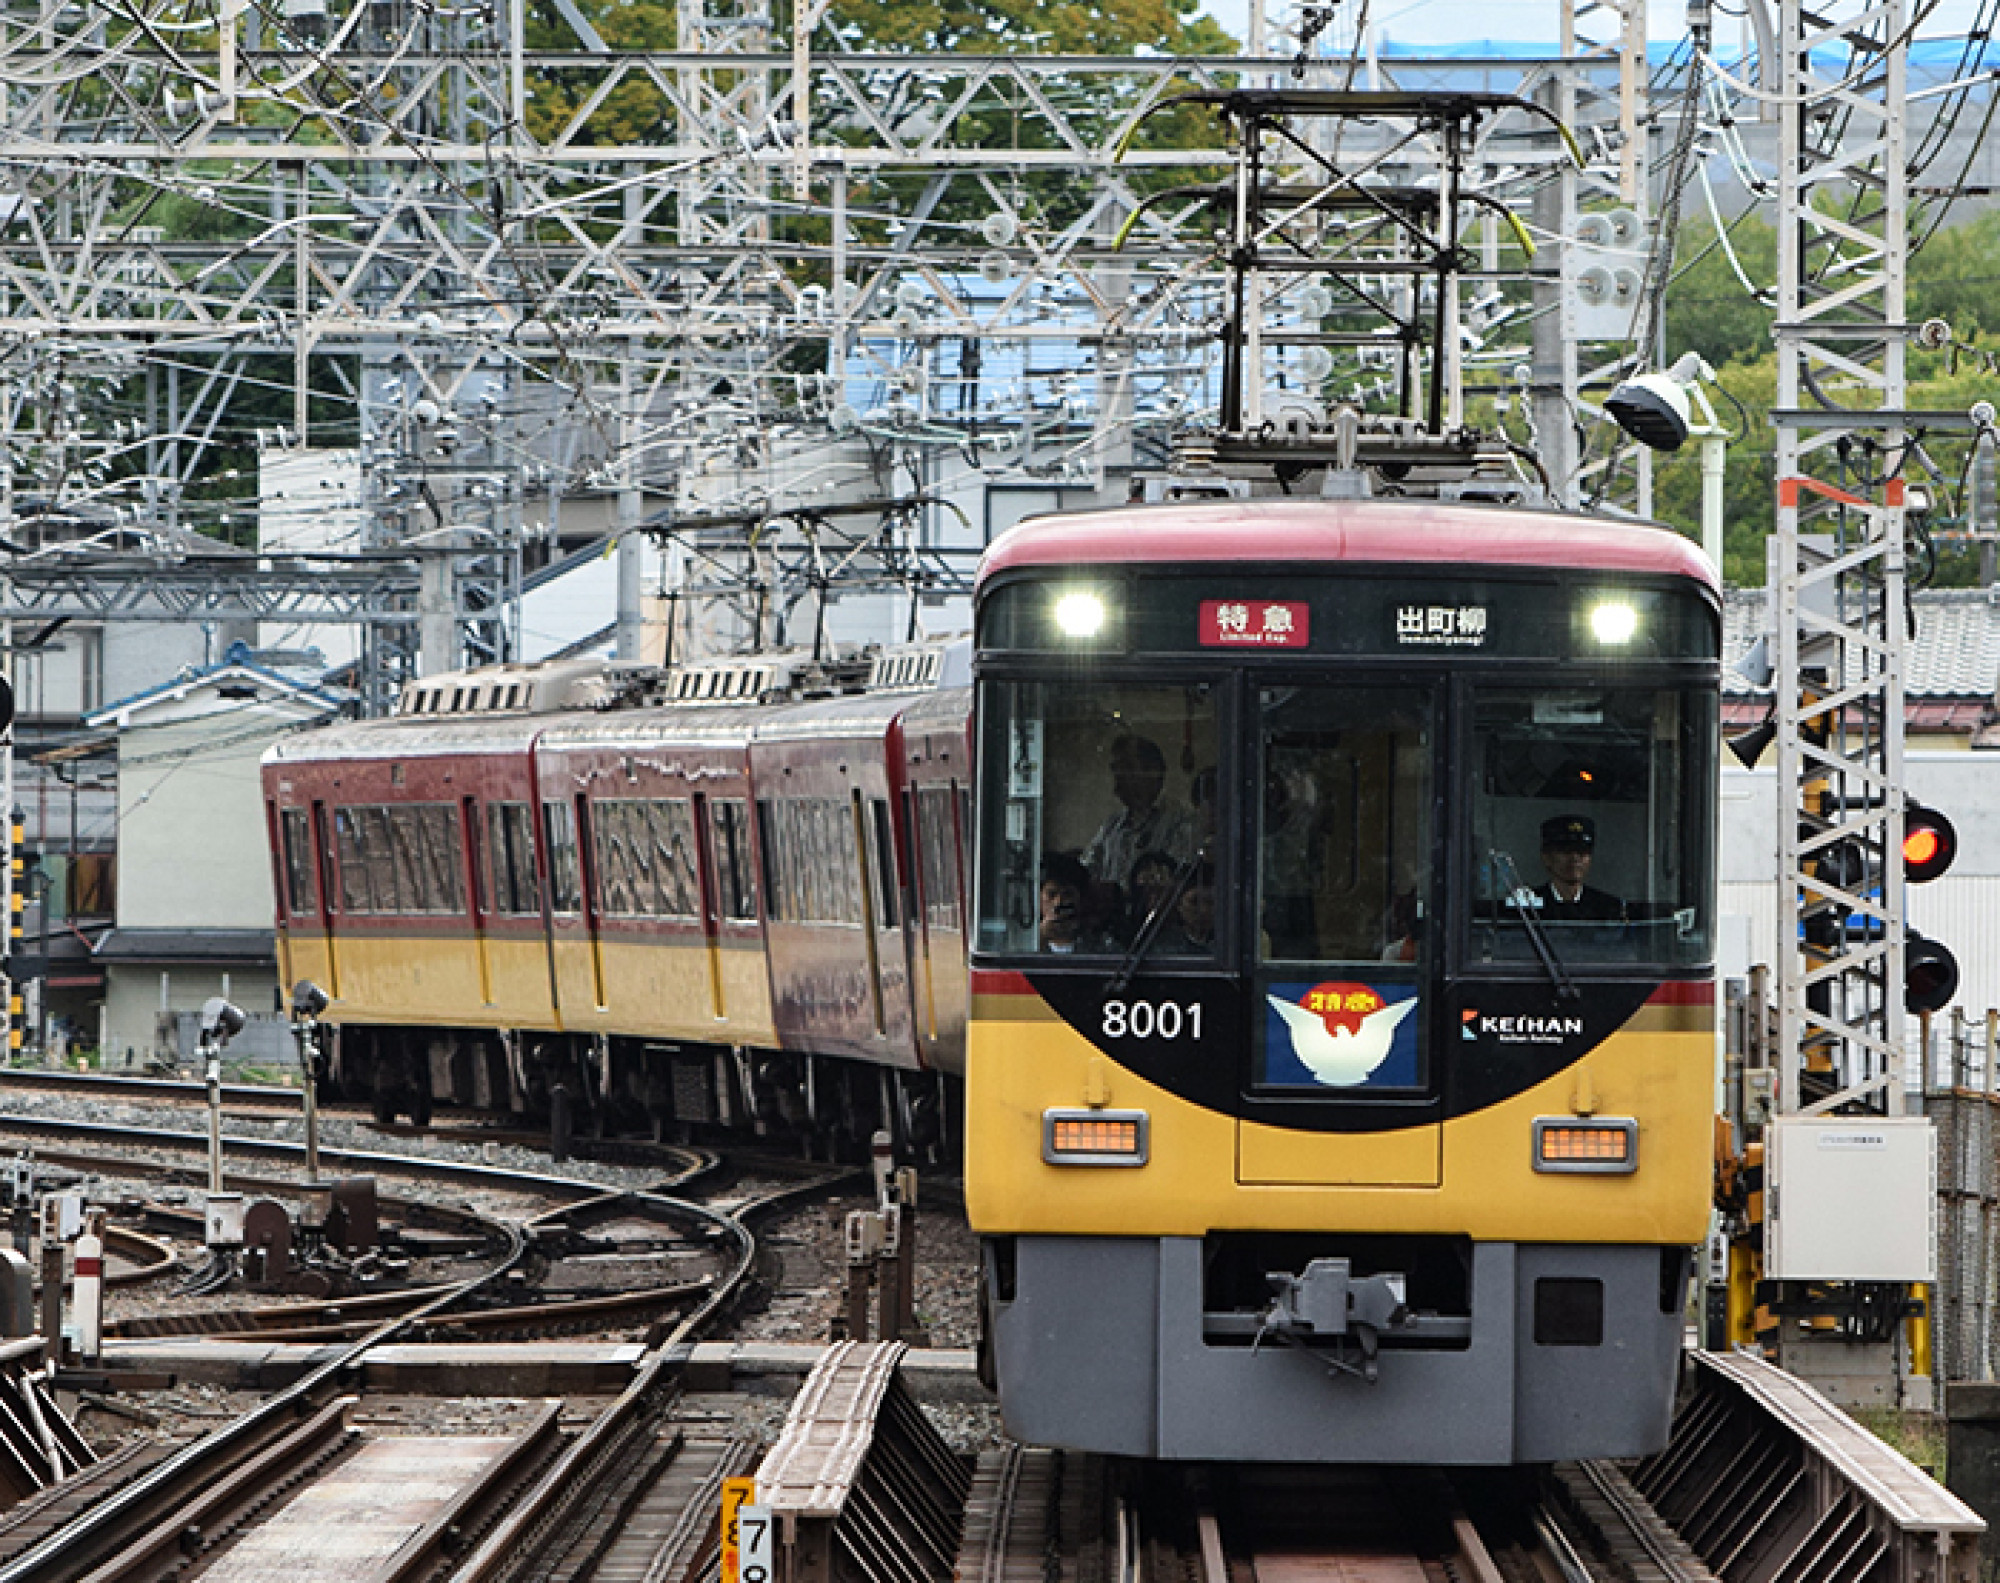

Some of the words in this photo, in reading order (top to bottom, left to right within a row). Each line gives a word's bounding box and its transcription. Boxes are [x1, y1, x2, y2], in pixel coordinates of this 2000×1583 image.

[1397, 606, 1486, 634] 出町柳
[1101, 1000, 1202, 1039] 8001
[1480, 1014, 1584, 1034] KEIHAN
